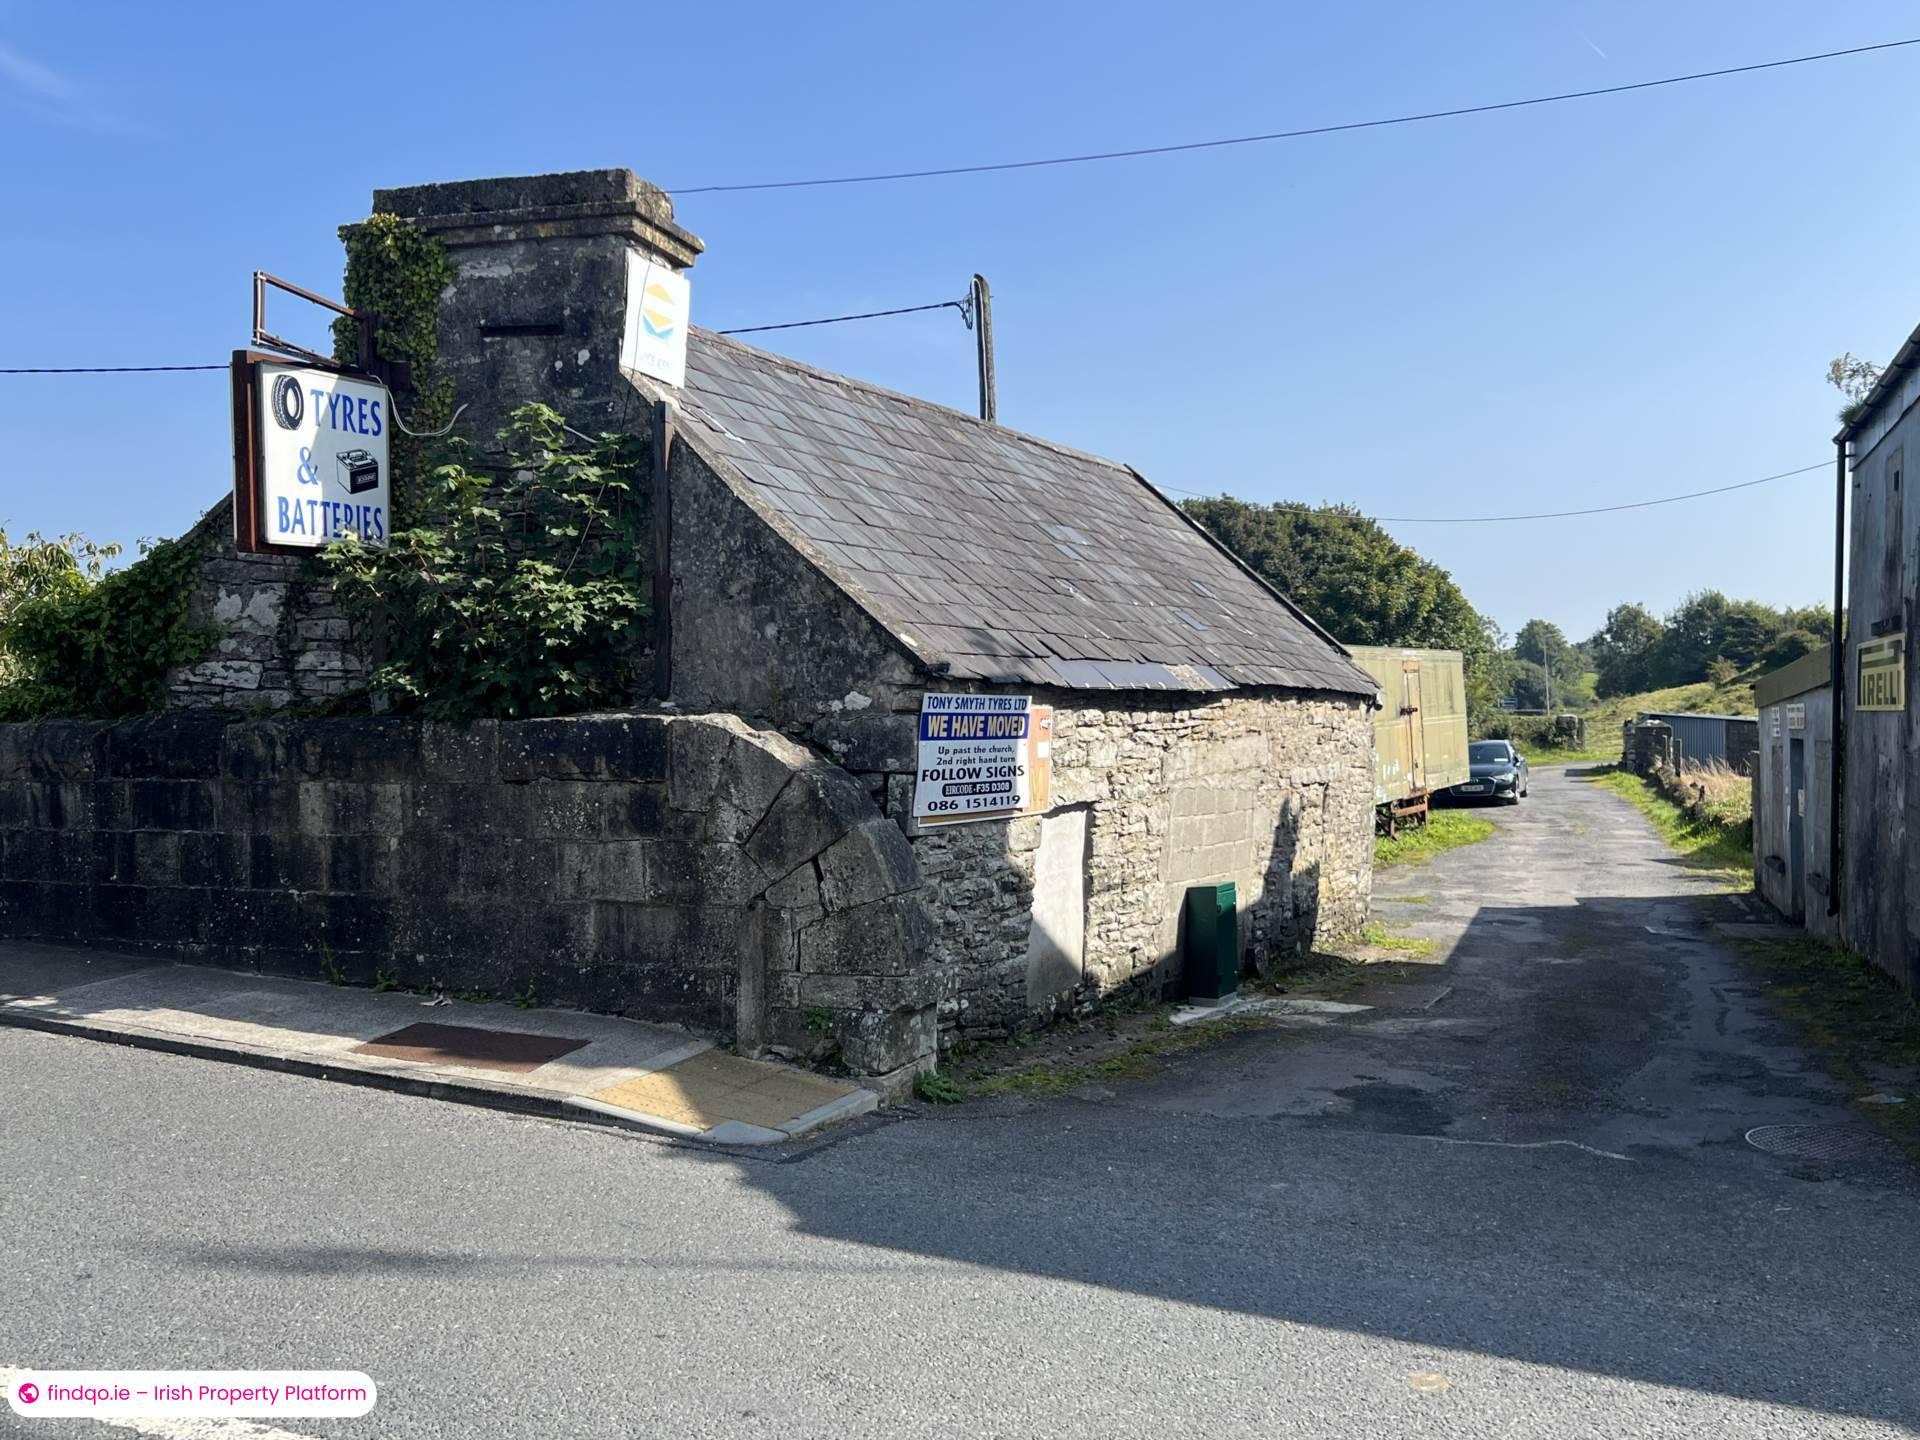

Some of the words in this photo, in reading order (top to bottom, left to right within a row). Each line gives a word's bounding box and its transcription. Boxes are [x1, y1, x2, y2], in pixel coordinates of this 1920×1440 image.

[310, 389, 382, 437] TYRES
[297, 446, 319, 485] &
[277, 496, 383, 540] BATTERIES
[928, 696, 952, 709] TONY
[955, 697, 985, 710] SMYTH
[989, 698, 1012, 710] TYRES
[1014, 700, 1027, 710] LTD
[928, 715, 948, 737] WE
[951, 716, 985, 737] HAVE
[987, 716, 1025, 736] MOVED
[938, 746, 949, 754] Up
[953, 747, 970, 755] past
[956, 758, 976, 766] right
[922, 767, 982, 781] FOLLOW
[987, 766, 1024, 777] SIGNS
[928, 800, 958, 811] 086
[966, 795, 1021, 809] 1514119
